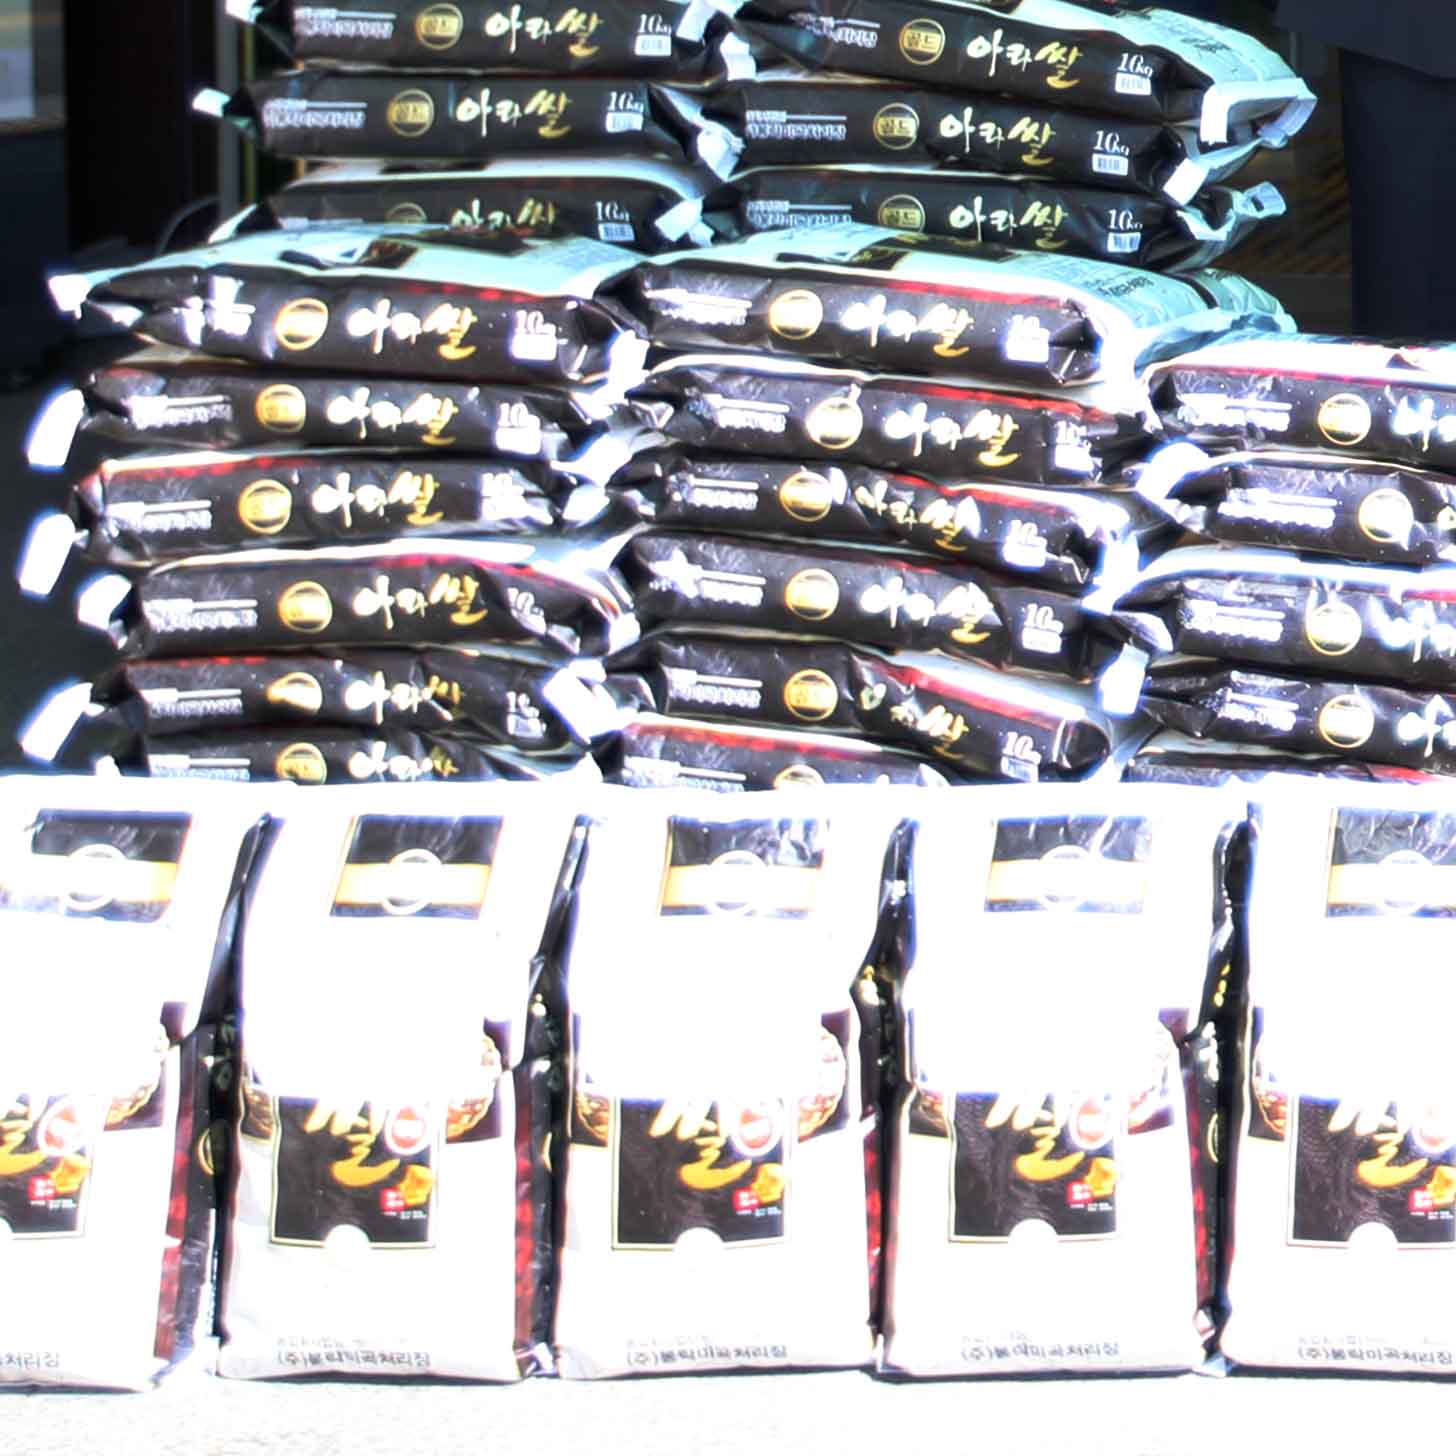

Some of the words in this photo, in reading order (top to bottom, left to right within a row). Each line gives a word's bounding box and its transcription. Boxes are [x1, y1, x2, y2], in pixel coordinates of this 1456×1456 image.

[486, 4, 602, 58] 아라쌀
[967, 29, 1082, 88] 아라쌀
[456, 88, 571, 138] 아라쌀
[939, 108, 1057, 166] 아라쌀
[949, 196, 1068, 249] 아라쌀
